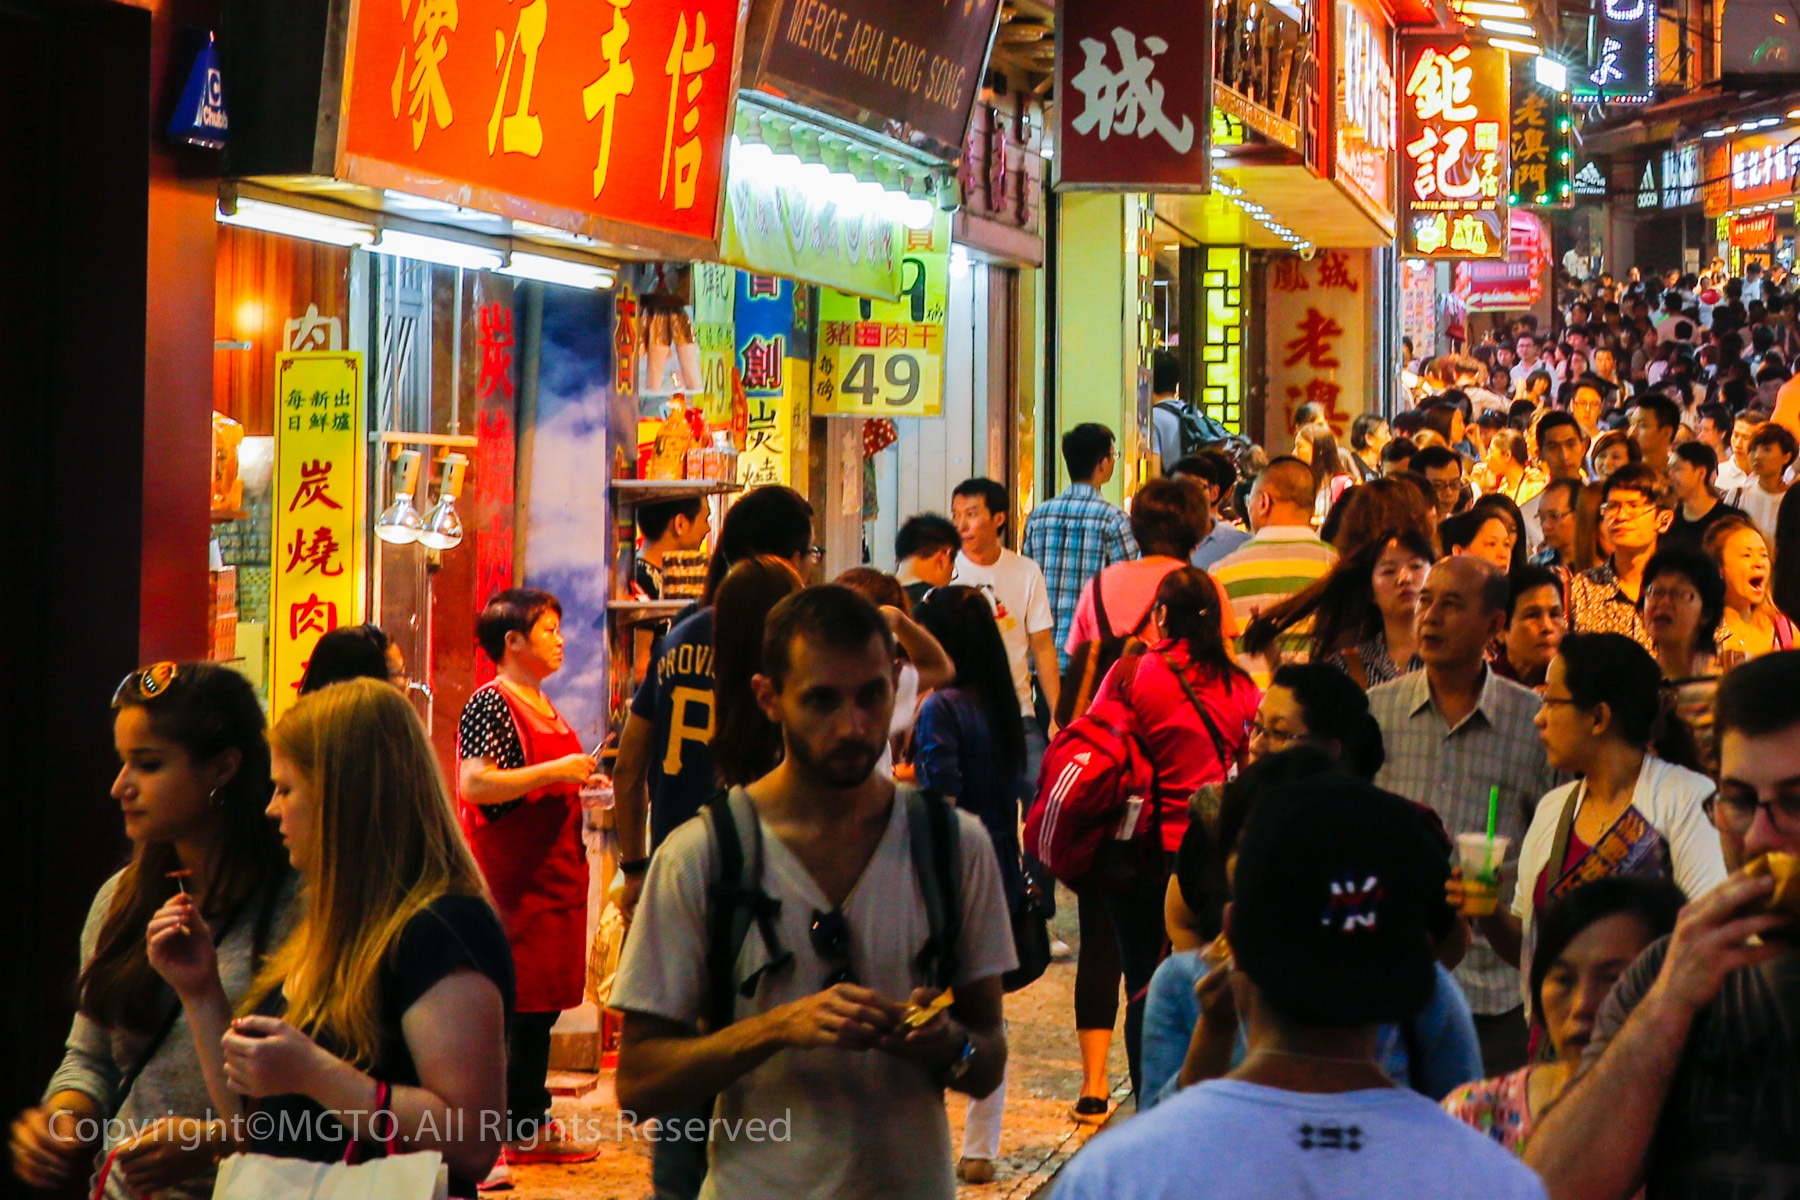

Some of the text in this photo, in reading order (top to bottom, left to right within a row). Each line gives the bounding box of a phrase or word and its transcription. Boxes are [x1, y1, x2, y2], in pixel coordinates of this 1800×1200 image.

[844, 20, 886, 75] ARIA
[882, 37, 926, 91] FONG
[924, 56, 968, 111] SONG
[1405, 44, 1480, 201] 鉅記
[840, 353, 921, 407] 49
[286, 458, 345, 693] 炭燒肉
